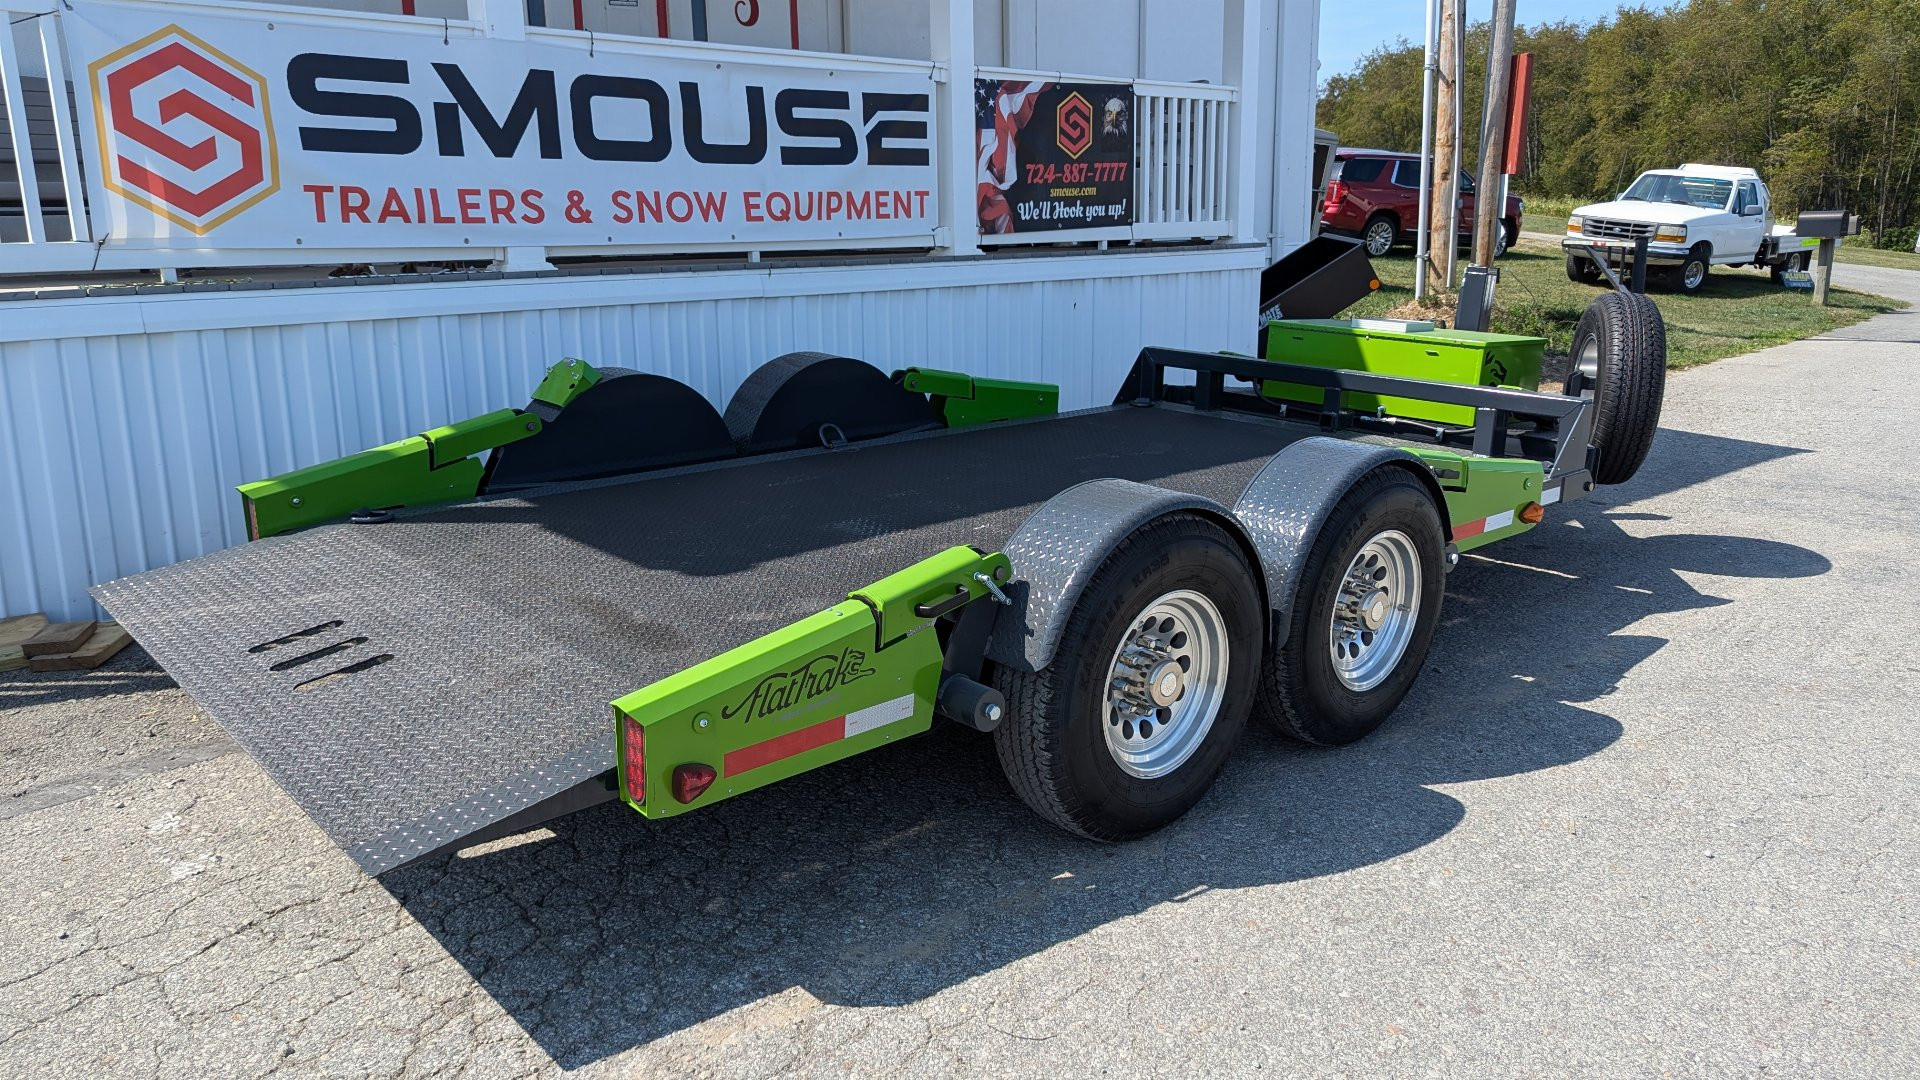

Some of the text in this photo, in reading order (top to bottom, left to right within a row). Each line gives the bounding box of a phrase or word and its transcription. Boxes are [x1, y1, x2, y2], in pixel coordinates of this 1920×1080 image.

[287, 53, 930, 166] SMOUSE
[1026, 162, 1128, 184] 724-887-7777
[1050, 186, 1097, 197] smouse.com
[303, 185, 931, 224] TRAILERS & SNOW EQUIPMENT
[1017, 198, 1127, 222] We'll Hook you up!
